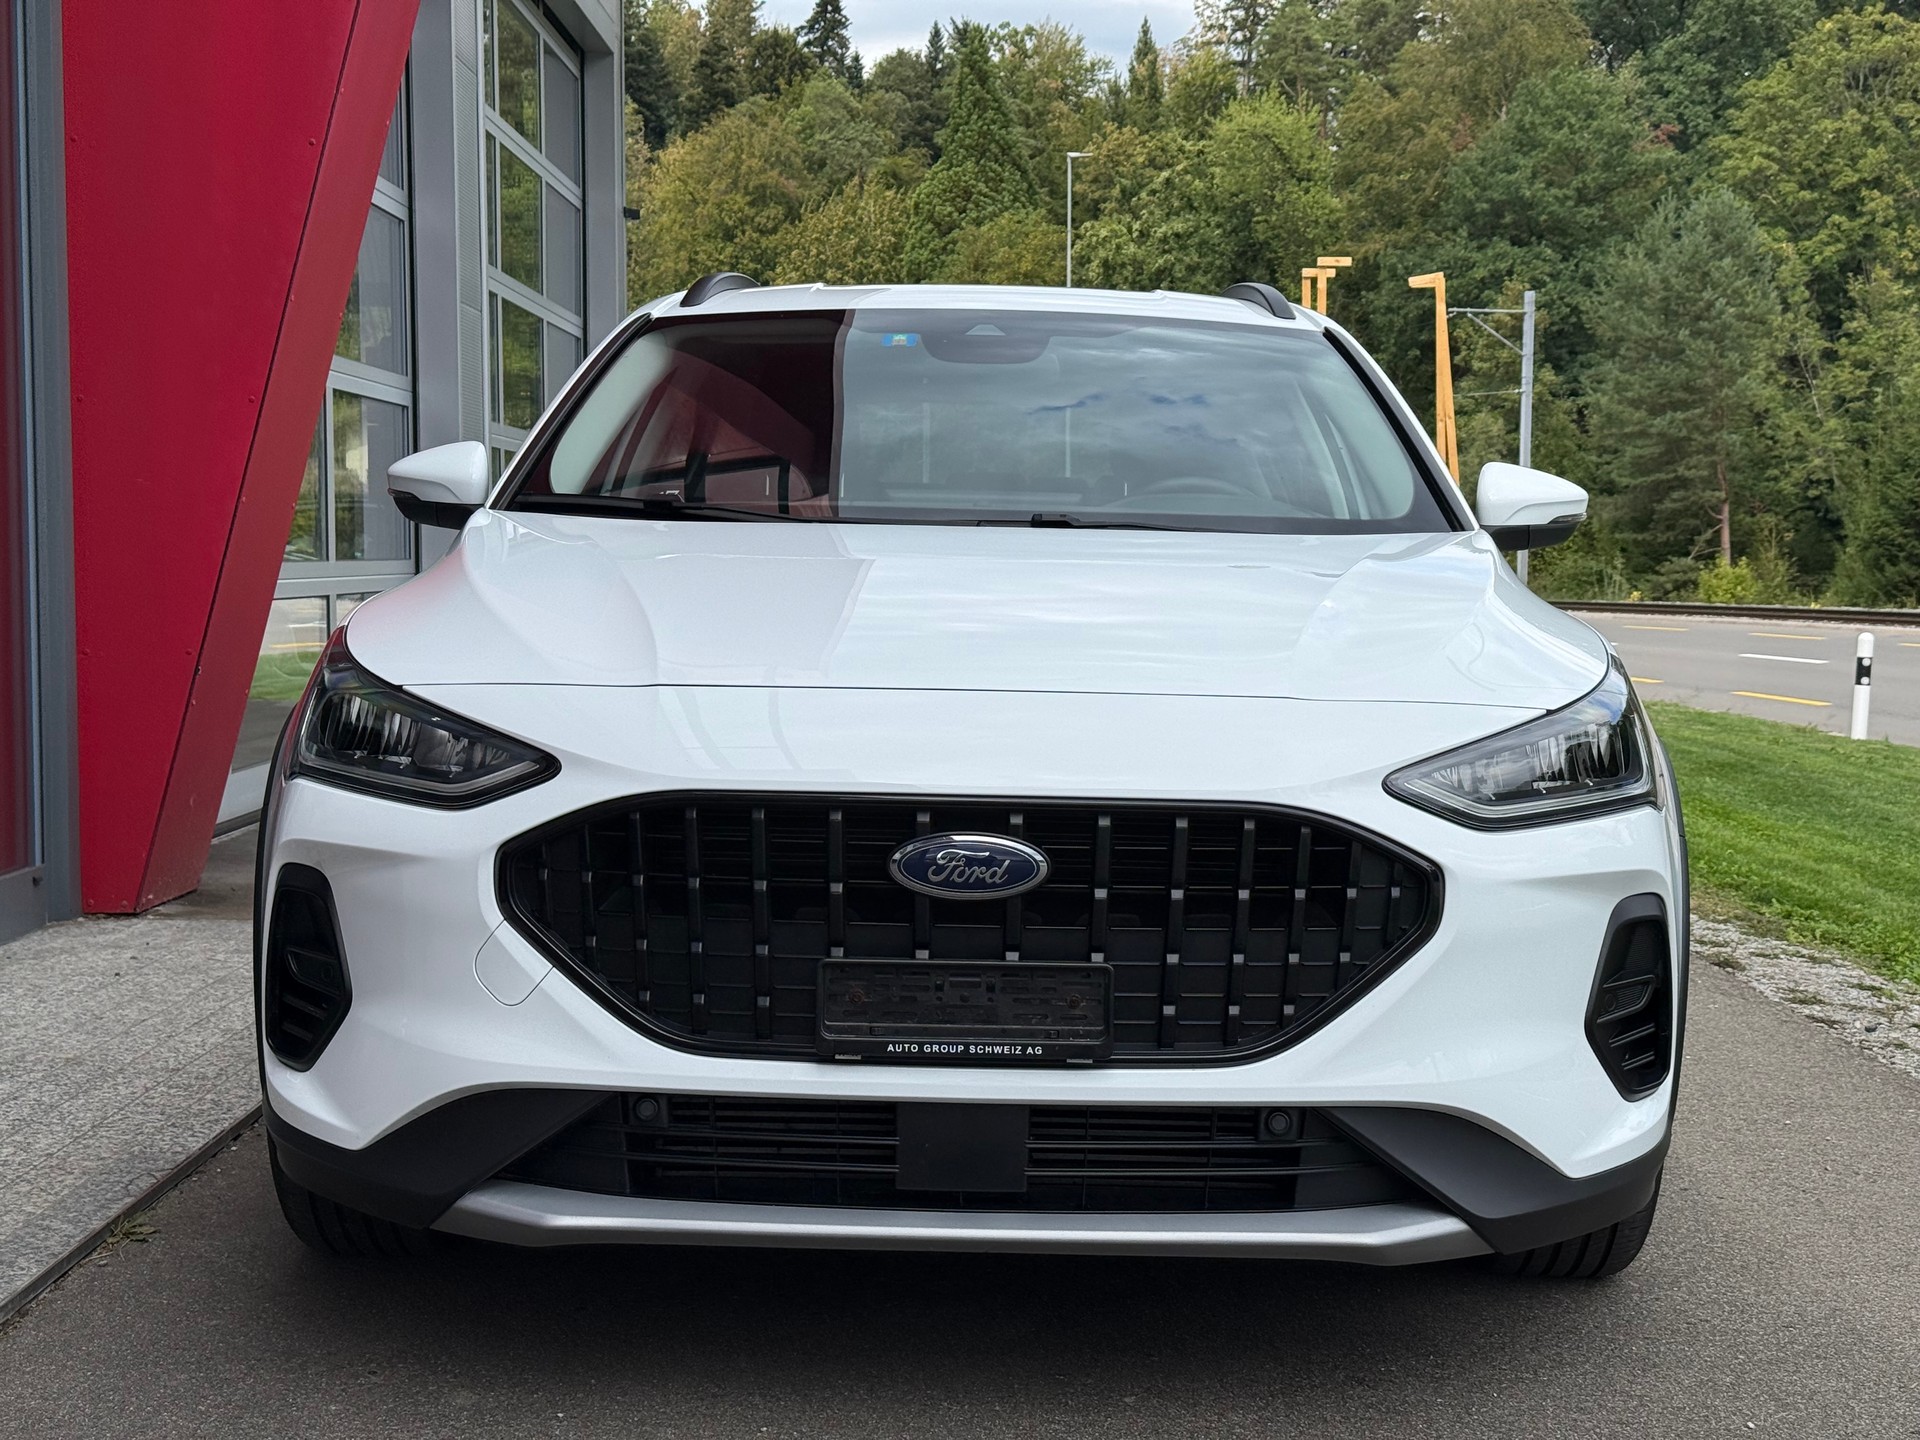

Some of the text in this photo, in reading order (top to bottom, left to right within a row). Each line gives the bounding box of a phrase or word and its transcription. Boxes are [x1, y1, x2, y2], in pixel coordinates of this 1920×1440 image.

[927, 849, 1011, 884] Ford
[886, 1043, 1043, 1055] AUTO GROUP SCHWEIZ AG
